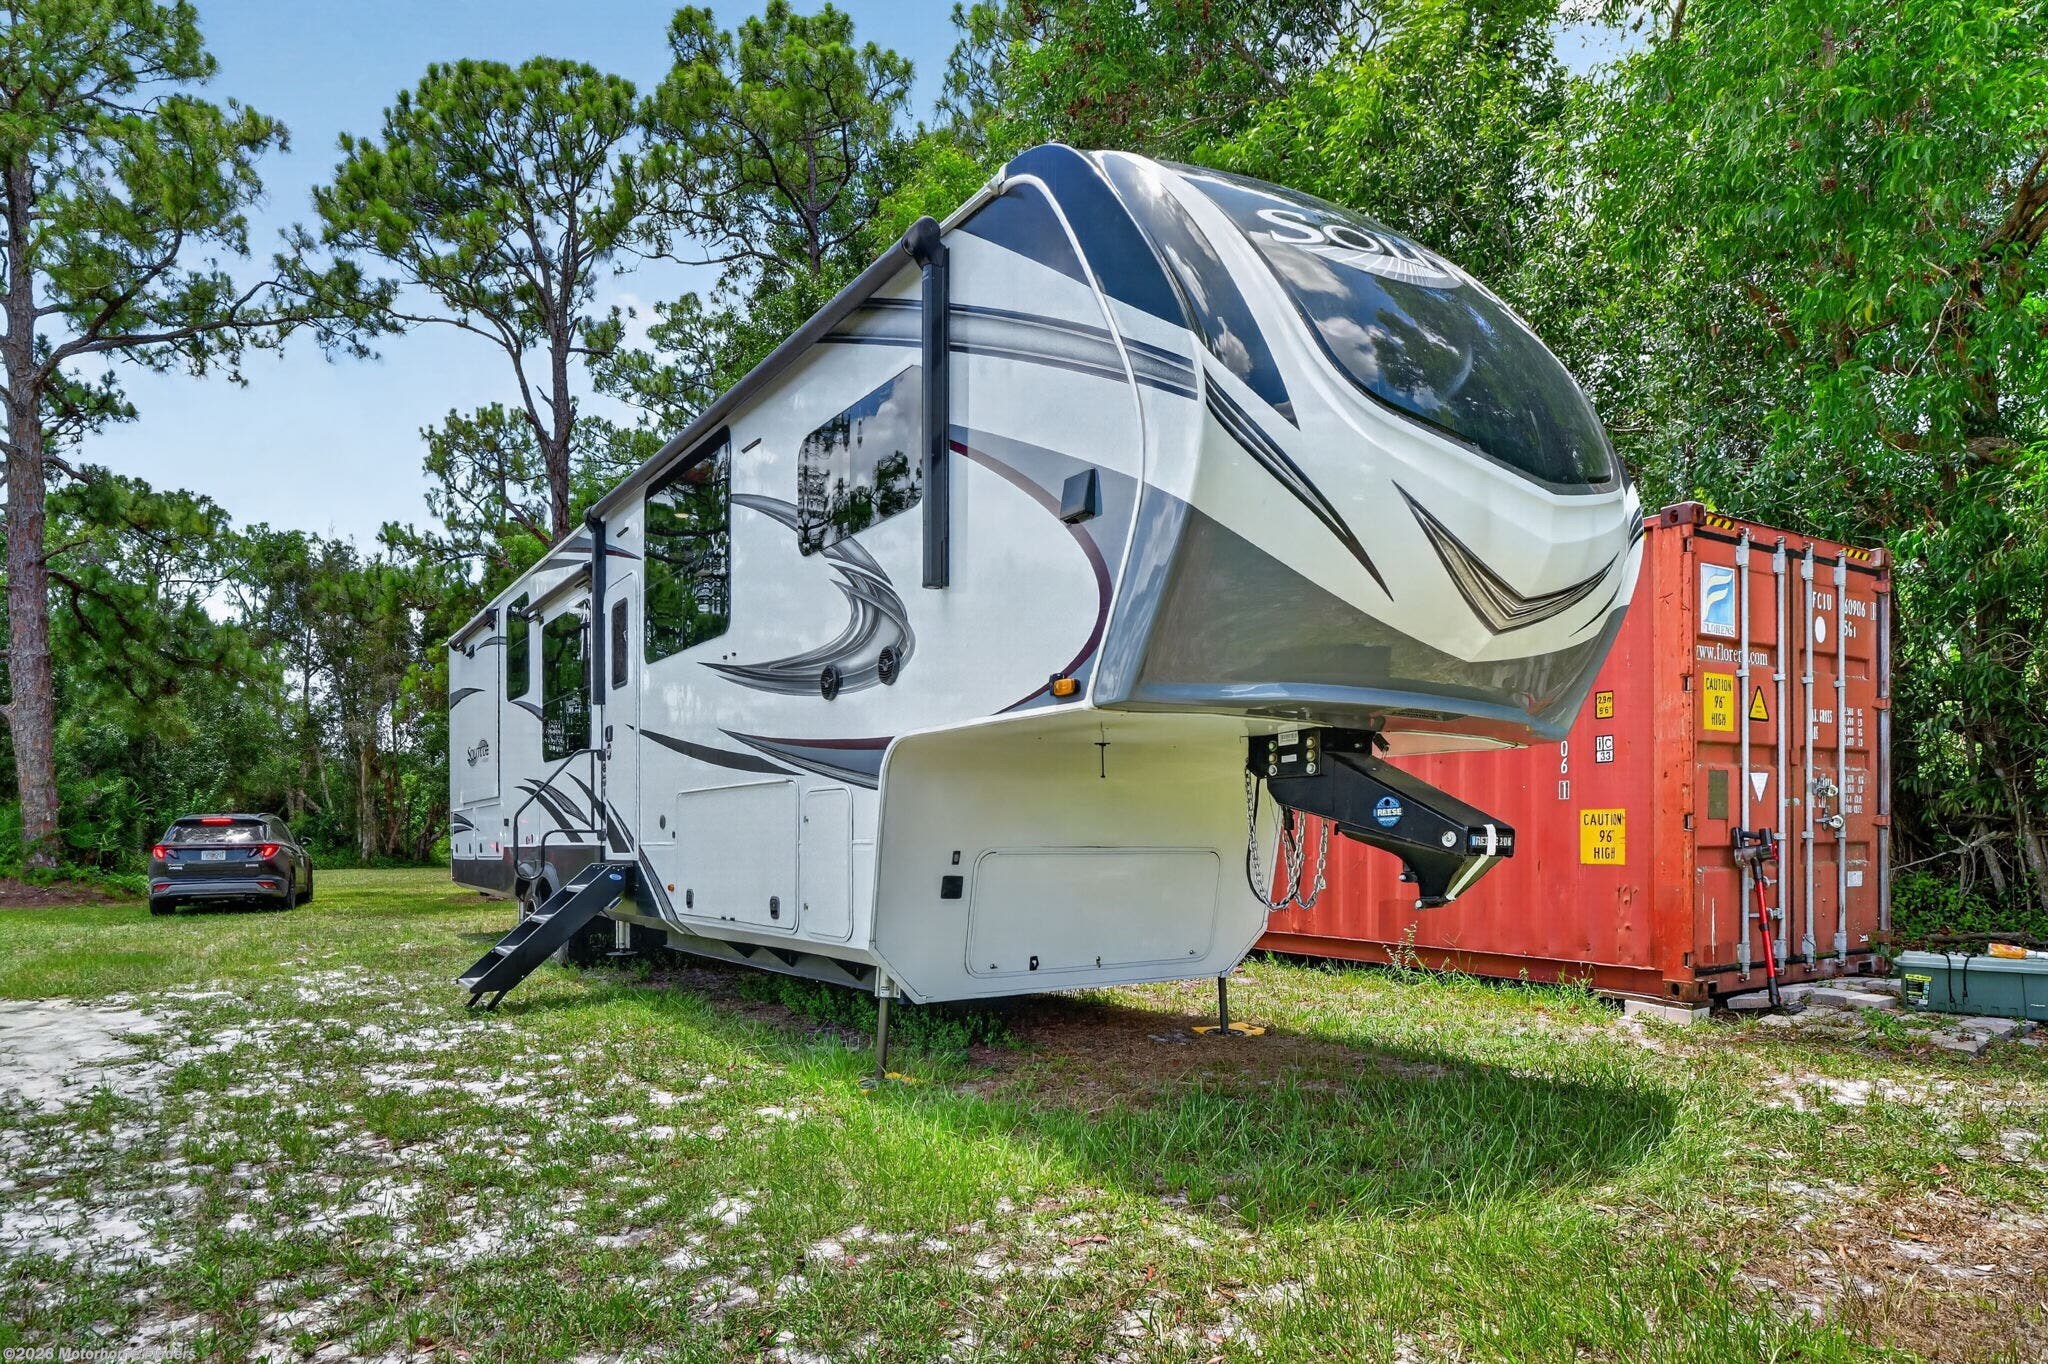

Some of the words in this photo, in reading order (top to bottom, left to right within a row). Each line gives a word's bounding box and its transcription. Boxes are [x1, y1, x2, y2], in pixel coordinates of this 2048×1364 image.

[1705, 677, 1732, 692] CAUTION
[1711, 712, 1727, 726] HIGH
[1600, 752, 1611, 760] 33
[1377, 808, 1402, 816] REESE
[1583, 813, 1622, 826] CAUTION
[1593, 847, 1616, 860] HIGH
